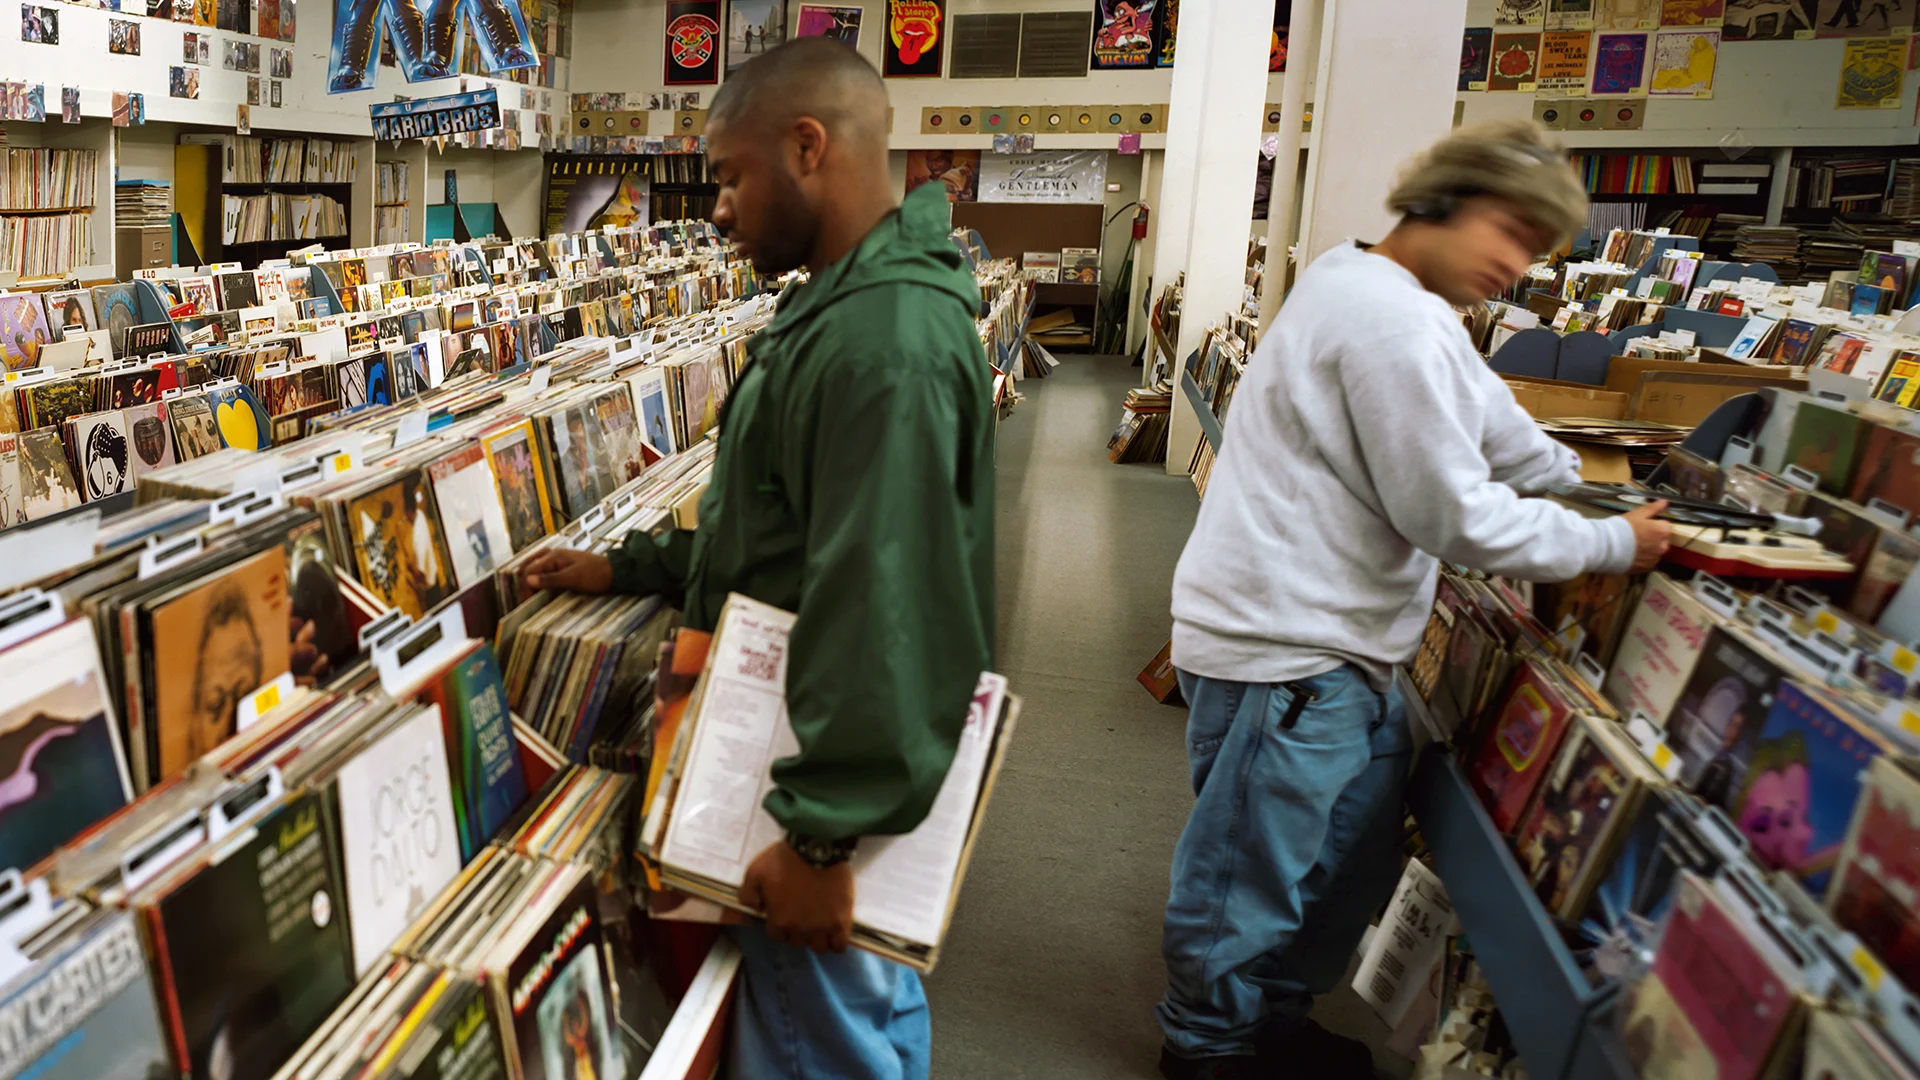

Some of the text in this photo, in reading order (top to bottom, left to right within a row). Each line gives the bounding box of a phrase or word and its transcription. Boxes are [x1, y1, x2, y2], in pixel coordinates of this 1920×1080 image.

[904, 8, 935, 18] Stones
[1099, 53, 1147, 65] VICTIM
[383, 94, 480, 114] SUPER
[372, 104, 500, 141] MARIO BROS.
[998, 181, 1079, 191] GENTLEMAN
[142, 270, 156, 279] ELO
[106, 471, 113, 485] 6
